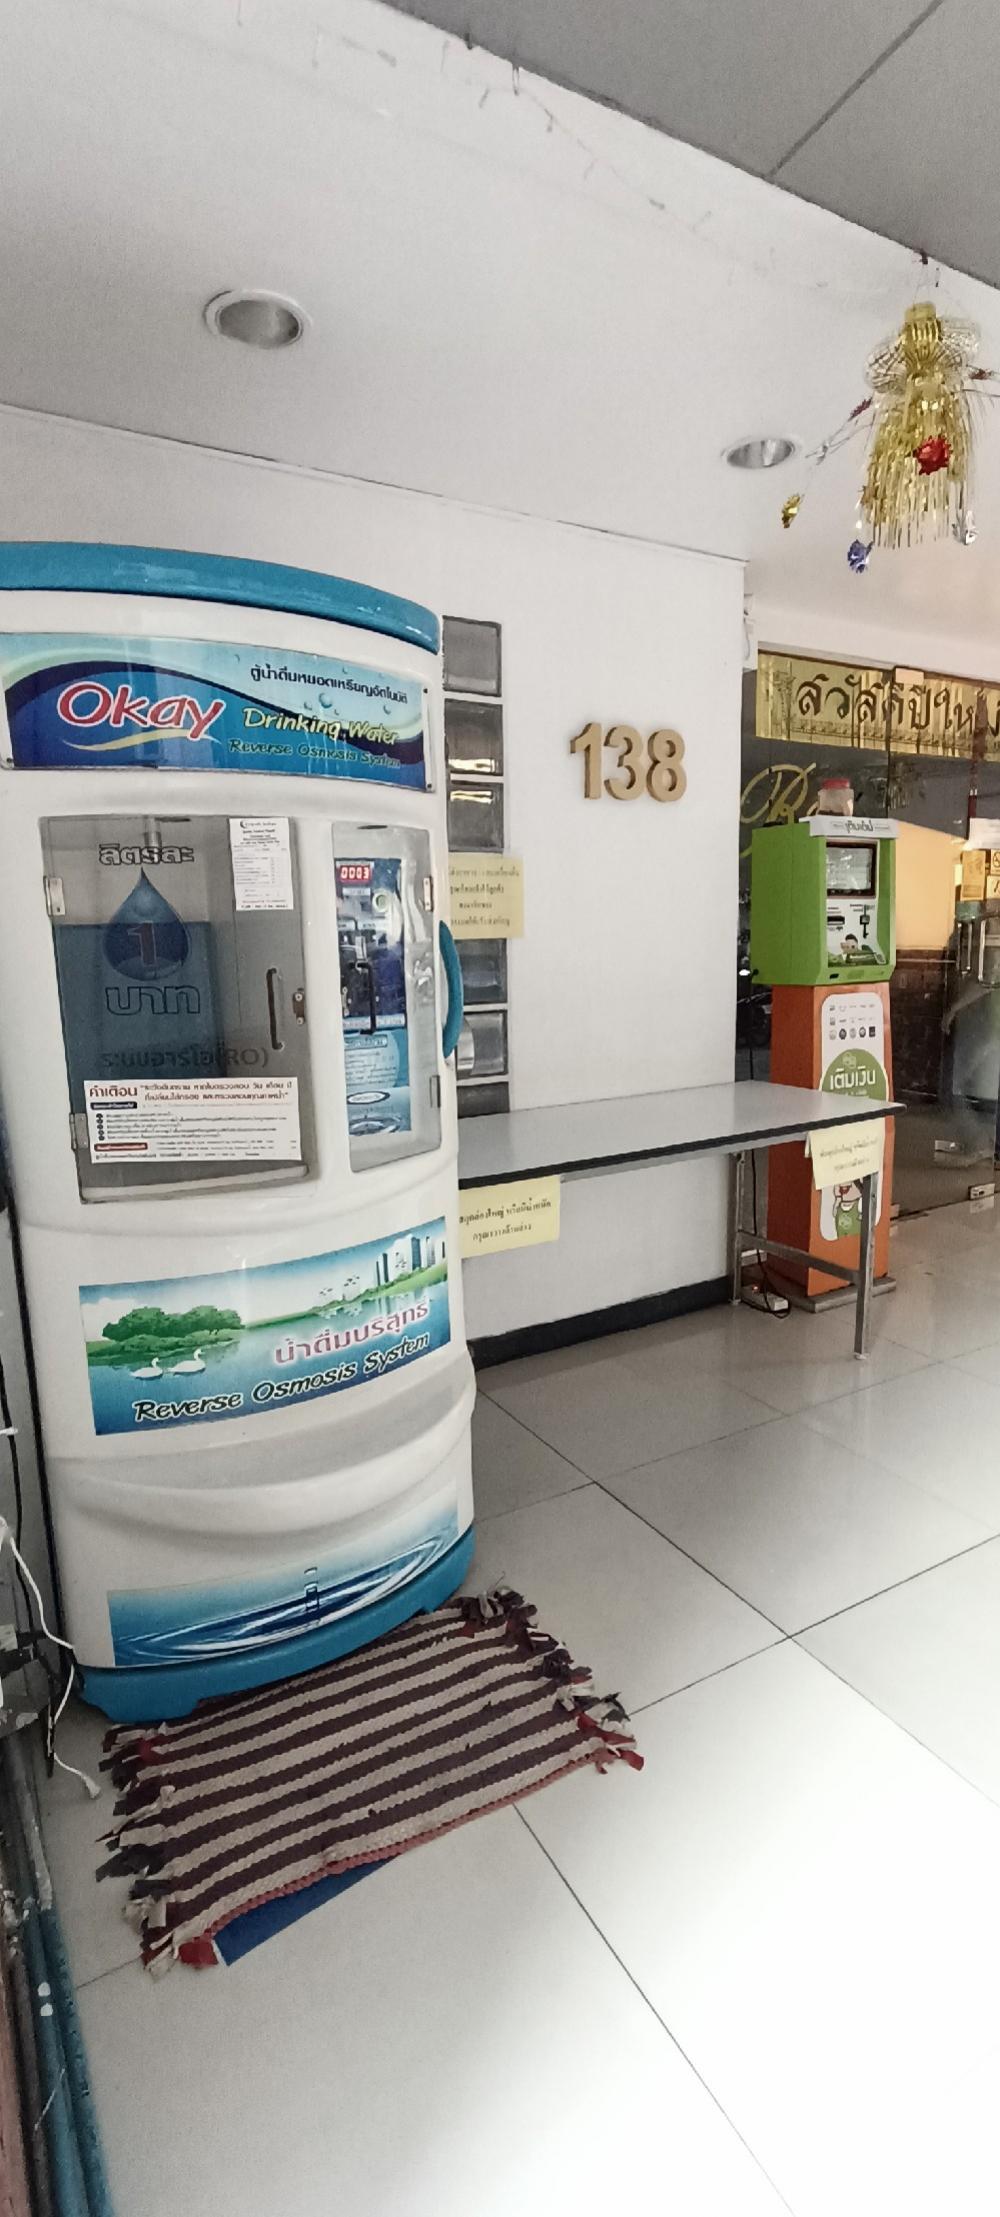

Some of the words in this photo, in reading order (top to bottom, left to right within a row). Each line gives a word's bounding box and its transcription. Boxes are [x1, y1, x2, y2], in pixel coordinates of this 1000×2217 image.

[57, 681, 226, 740] Okay
[243, 707, 341, 741] Drinking
[348, 720, 400, 745] Water
[229, 738, 292, 756] Reverse
[298, 743, 358, 761] Osmosis
[360, 751, 402, 769] System
[570, 722, 687, 803] 138
[99, 843, 195, 866] ลิตรละ
[341, 866, 369, 879] 0003
[128, 920, 157, 967] 1
[105, 985, 200, 1016] บาท
[89, 1084, 138, 1098] คำเตือน
[829, 1066, 876, 1091] เติมเงิน
[132, 1393, 243, 1423] Reverse
[252, 1362, 357, 1402] Osmosis
[363, 1332, 430, 1373] System
